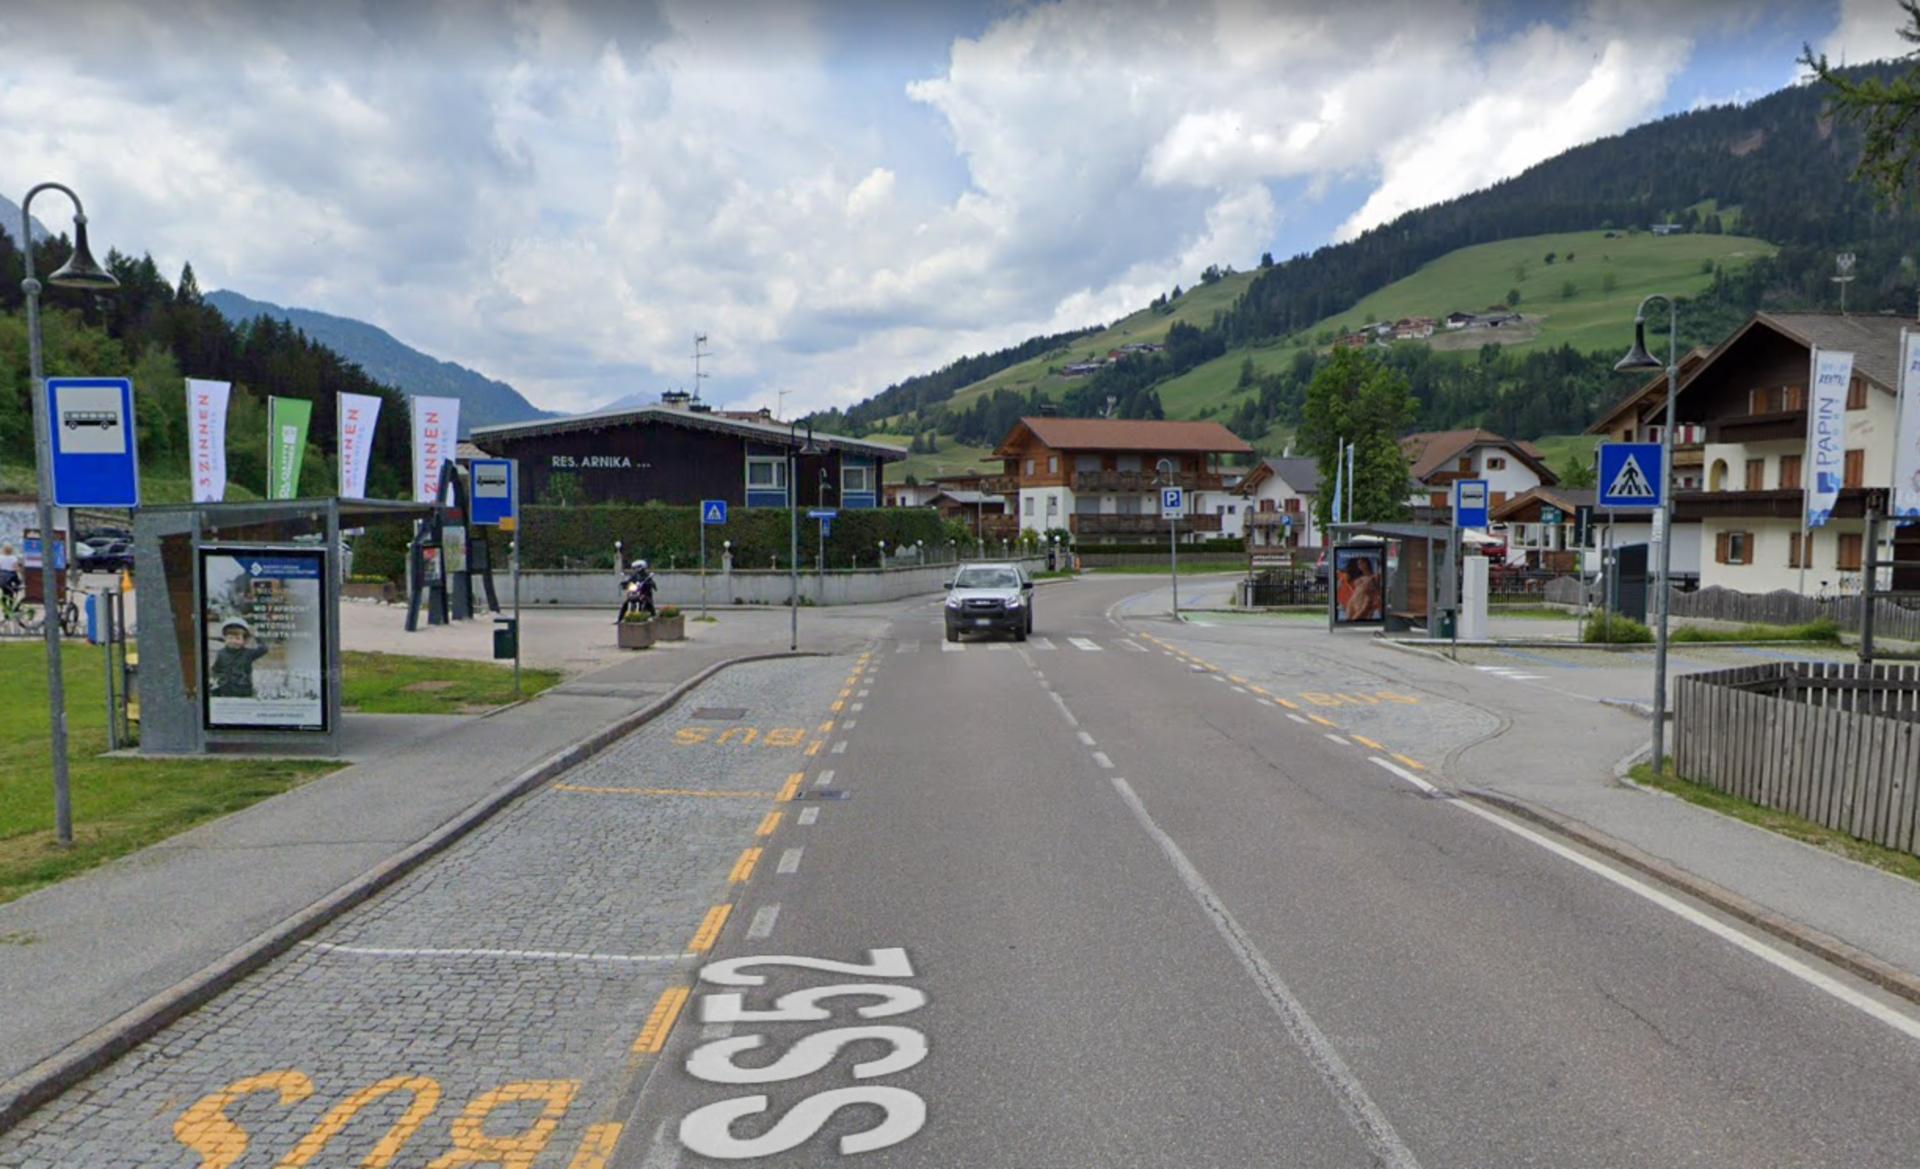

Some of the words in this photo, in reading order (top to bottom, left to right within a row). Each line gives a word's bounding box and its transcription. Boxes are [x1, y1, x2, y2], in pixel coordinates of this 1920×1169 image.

[198, 393, 210, 473] ZINNEN
[1816, 398, 1834, 466] PAPIN
[424, 411, 439, 494] ZINNEN
[551, 455, 578, 468] RES.
[581, 455, 631, 468] ARNIKA
[198, 478, 210, 487] 3
[1167, 492, 1177, 506] P
[671, 726, 806, 747] BUS
